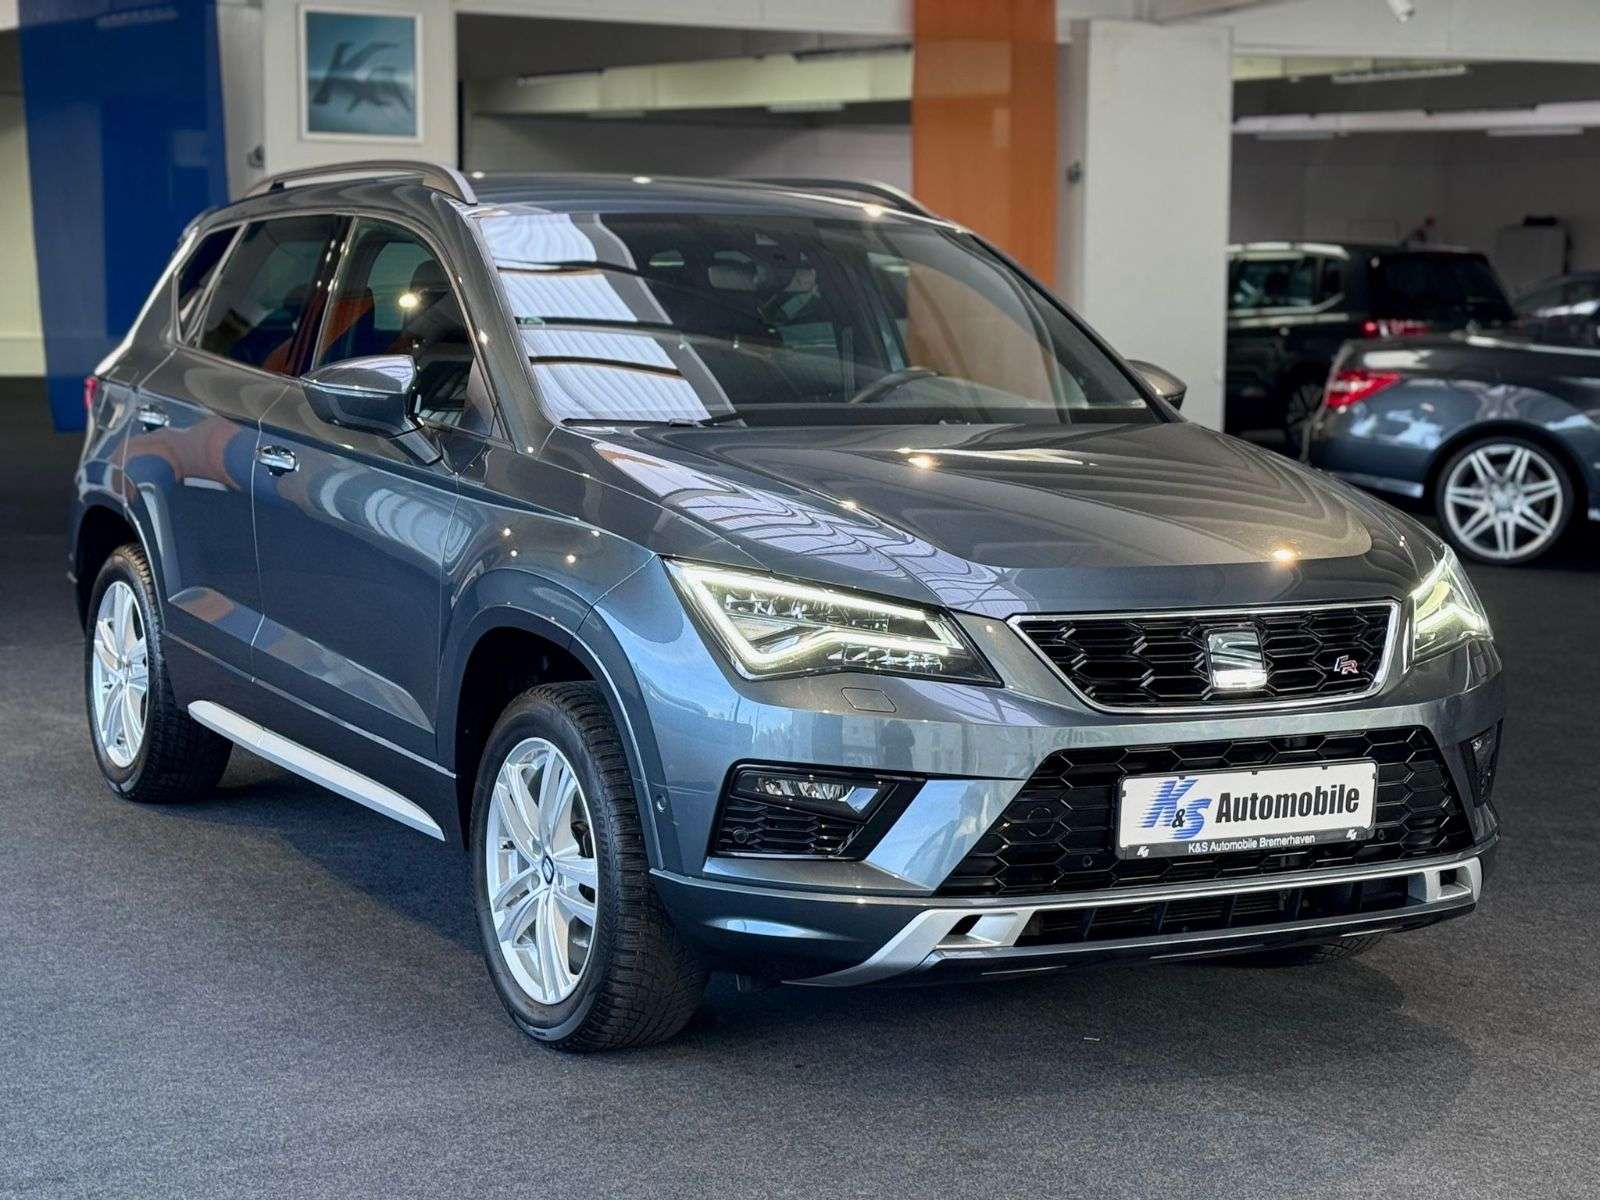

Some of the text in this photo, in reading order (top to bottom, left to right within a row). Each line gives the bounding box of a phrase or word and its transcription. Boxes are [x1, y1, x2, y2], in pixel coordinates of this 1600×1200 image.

[1215, 784, 1360, 823] Automobile
[1188, 834, 1316, 854] K&S Automobile Bremerhaven
